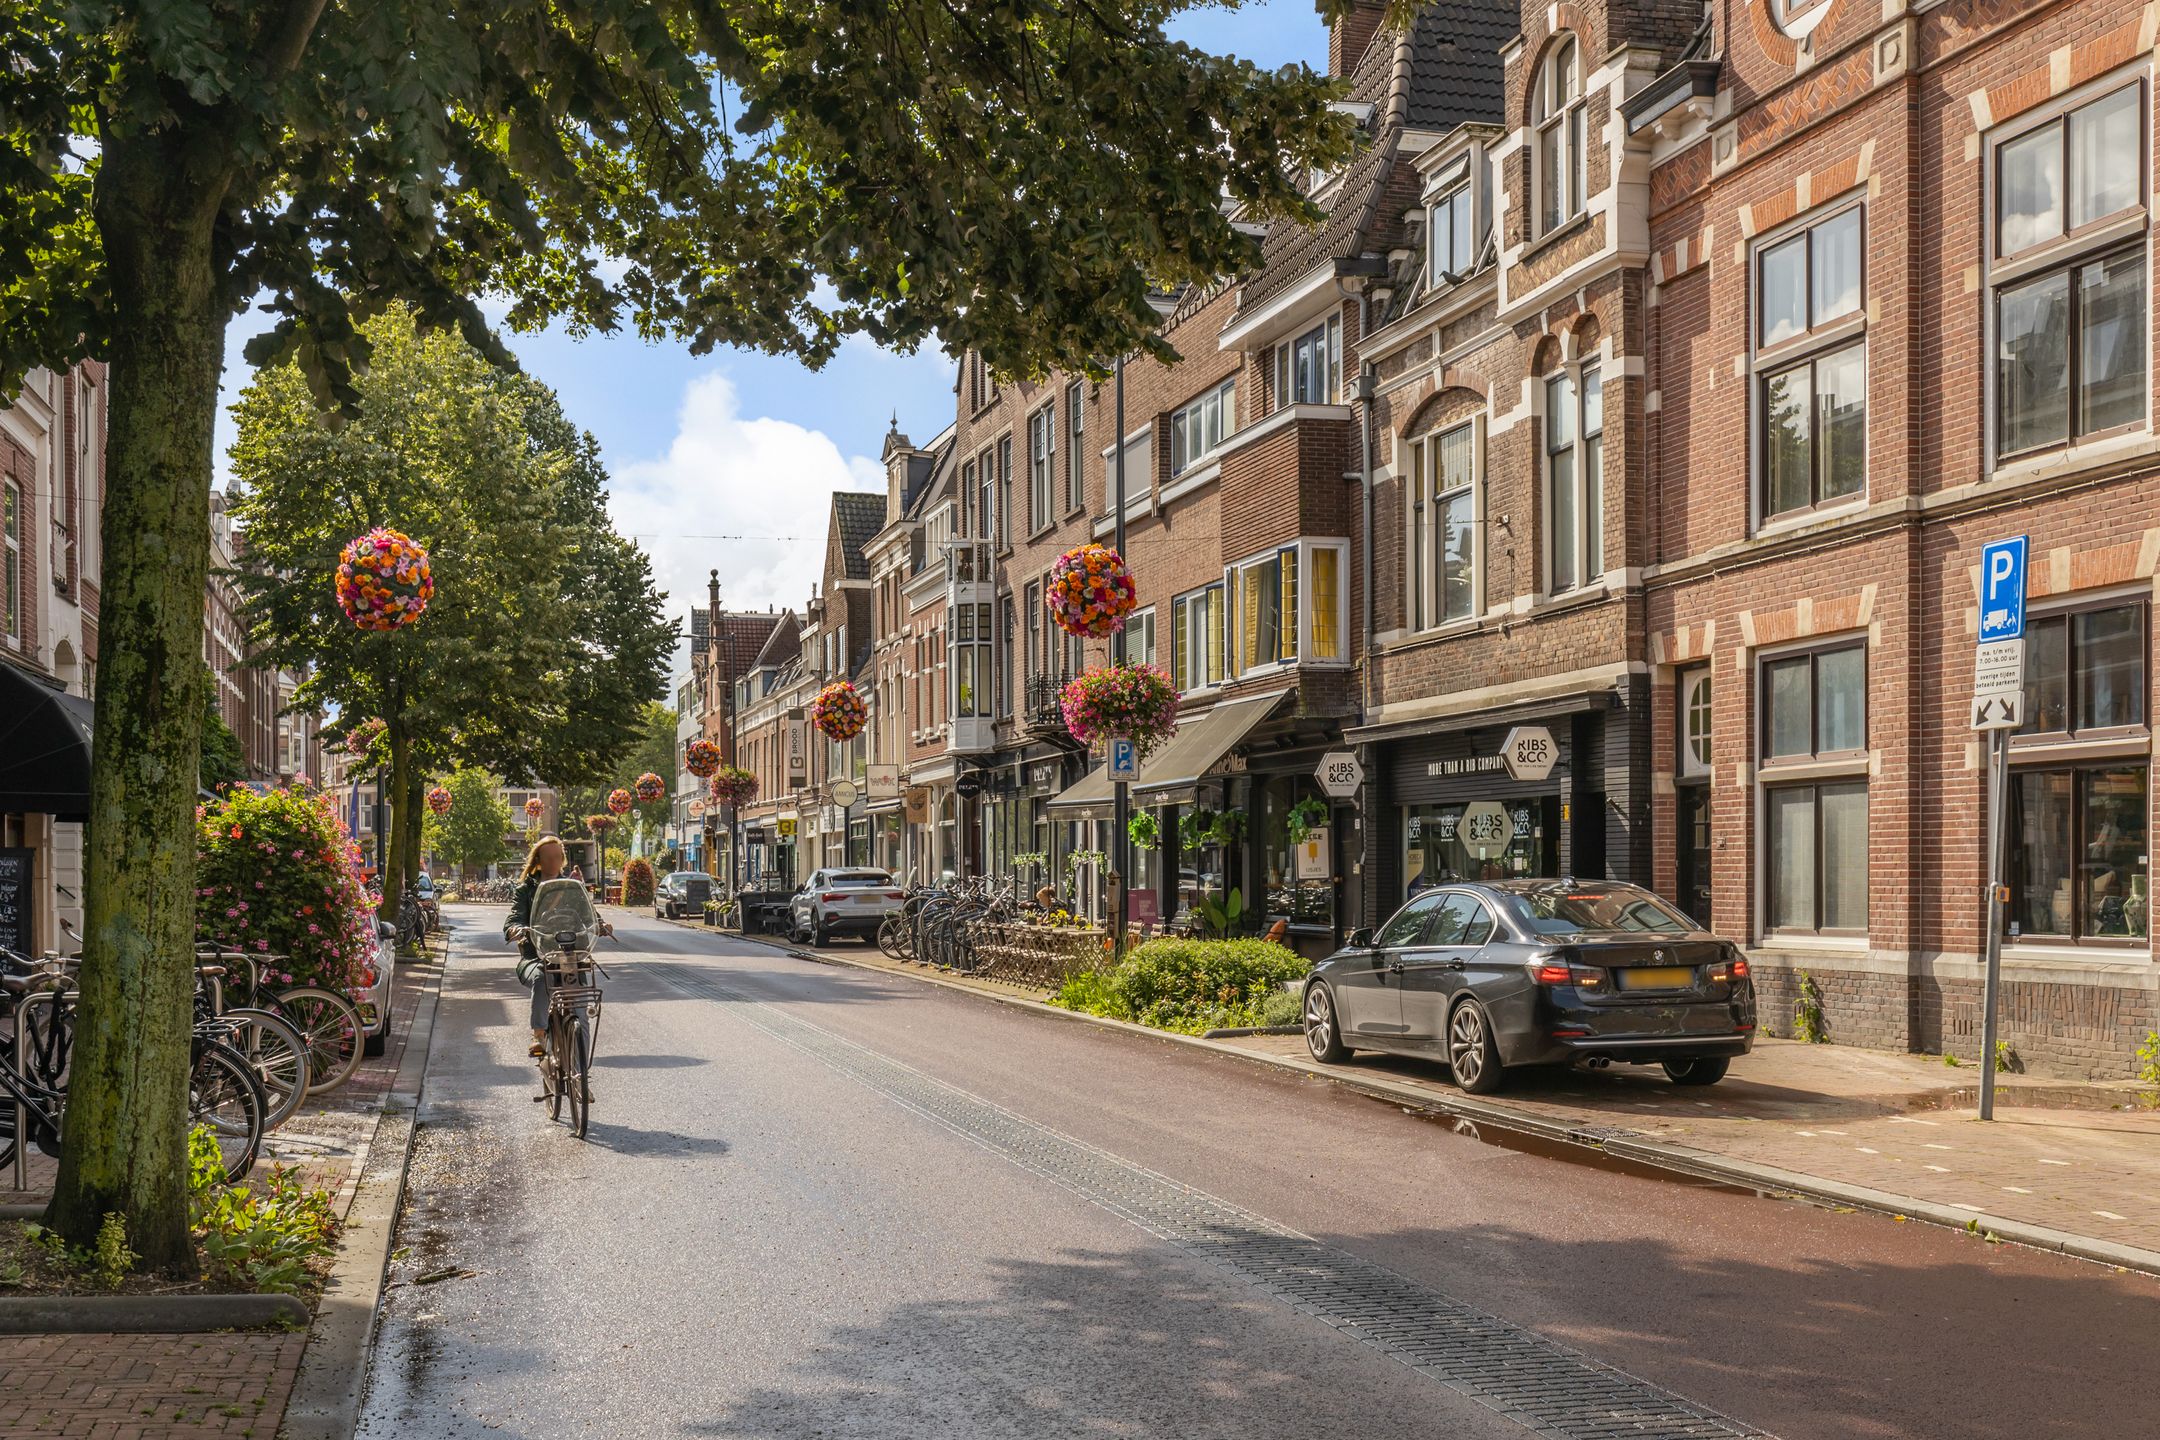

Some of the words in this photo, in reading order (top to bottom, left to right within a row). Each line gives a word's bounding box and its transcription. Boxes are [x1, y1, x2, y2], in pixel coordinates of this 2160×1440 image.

[1990, 550, 2013, 600] P
[1118, 743, 1129, 759] P
[1518, 739, 1547, 751] RIBS
[1517, 751, 1548, 763] &CO
[1328, 763, 1354, 772] RIBS
[1428, 762, 1442, 776] MORE
[1444, 760, 1458, 775] THAN
[1460, 759, 1464, 773] A
[1466, 758, 1476, 772] RIB
[1328, 773, 1354, 783] &CO
[1441, 815, 1454, 826] RIBS
[1514, 809, 1529, 821] RIBS
[1408, 817, 1420, 828] RIBS
